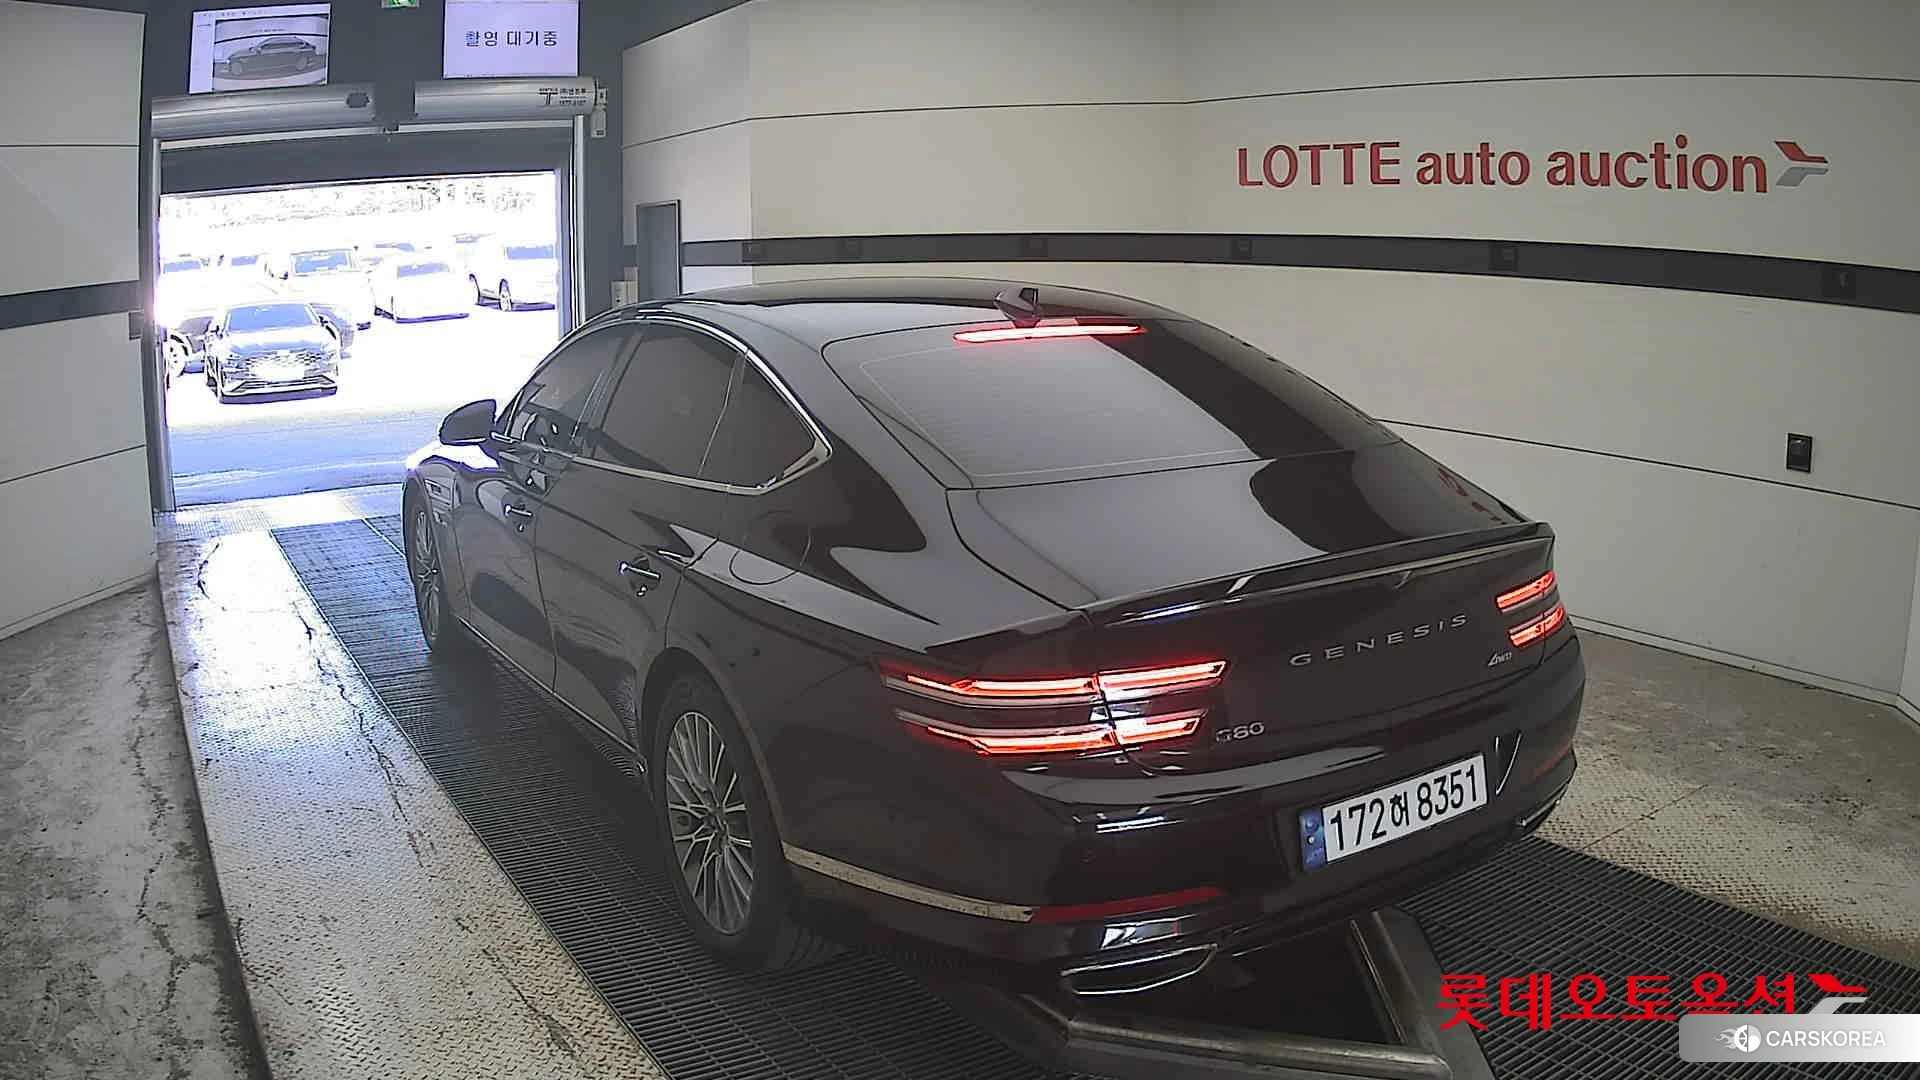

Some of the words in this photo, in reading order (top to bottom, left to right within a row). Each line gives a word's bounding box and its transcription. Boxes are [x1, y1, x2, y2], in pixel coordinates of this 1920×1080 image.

[506, 30, 558, 48] 대기중
[1236, 140, 1401, 188] LOTTE
[1415, 141, 1531, 187] auto
[1545, 134, 1769, 194] auction
[1288, 613, 1469, 667] GENESIS
[1215, 721, 1265, 744] G80
[1329, 790, 1411, 852] 172허
[1416, 763, 1478, 822] 8351
